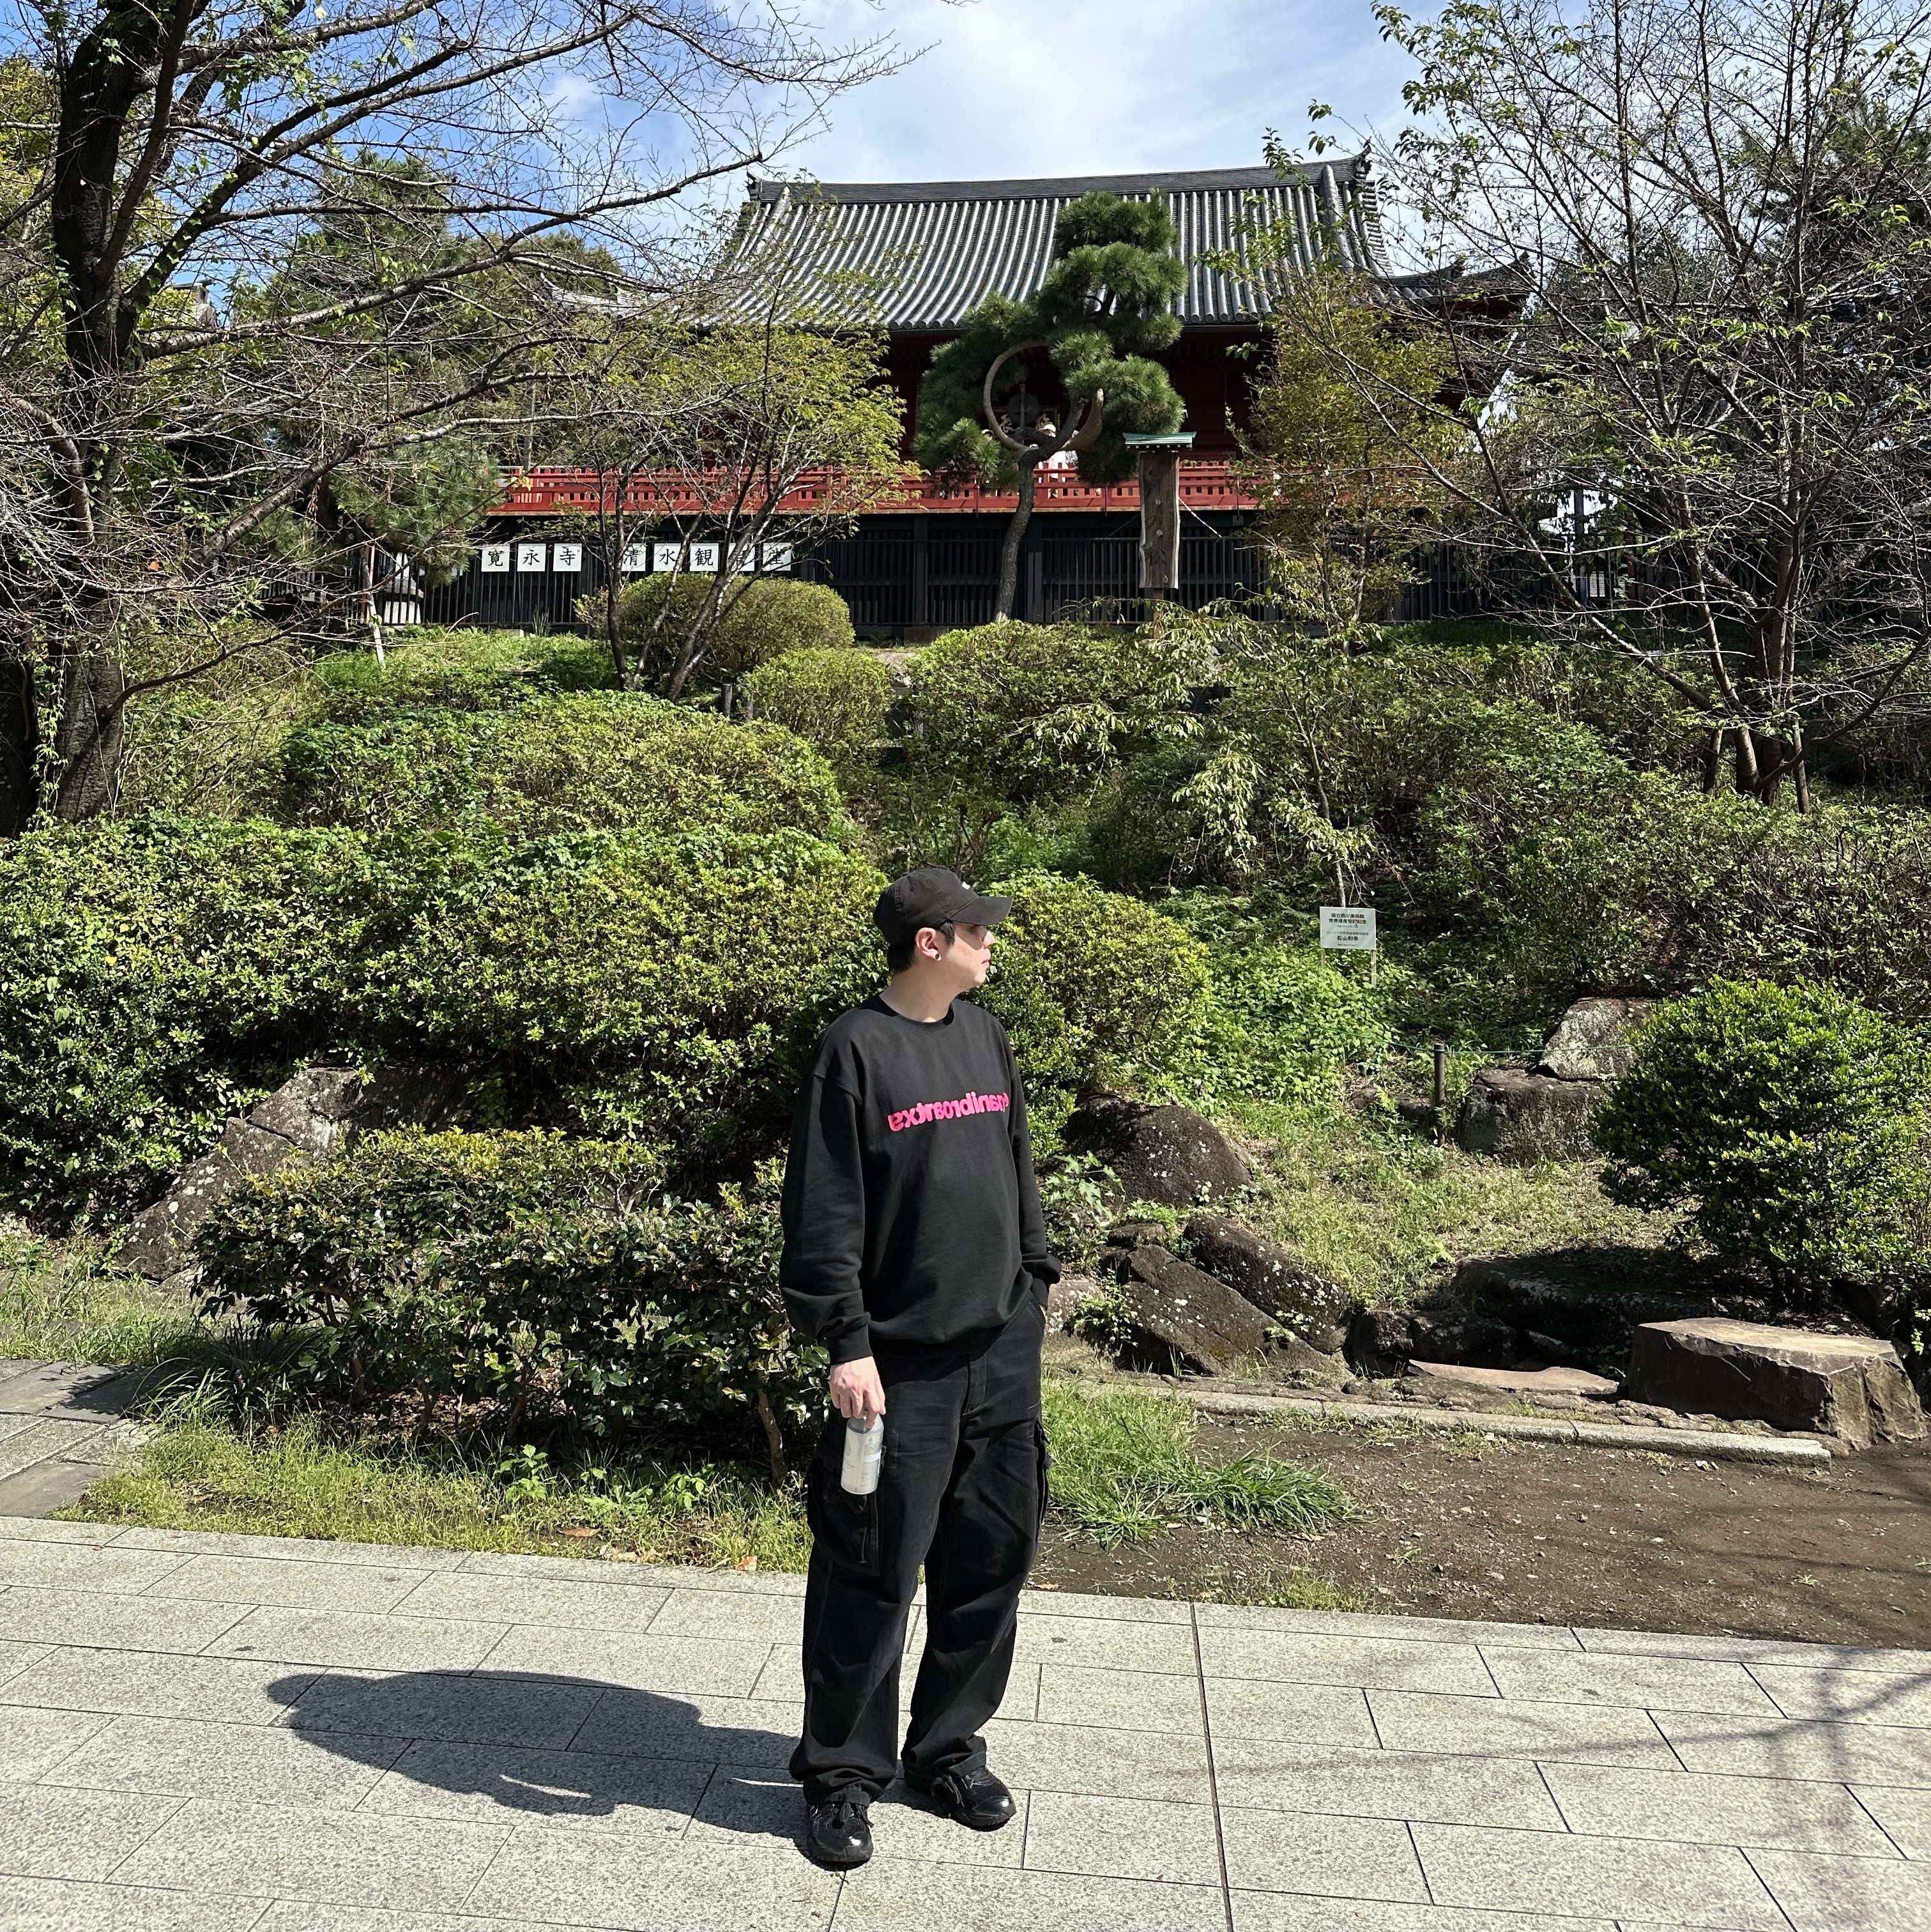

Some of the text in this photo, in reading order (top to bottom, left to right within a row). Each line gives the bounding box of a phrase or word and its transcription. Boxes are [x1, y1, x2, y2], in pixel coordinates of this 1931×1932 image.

[487, 548, 784, 567] 寛永寺 清水観堂
